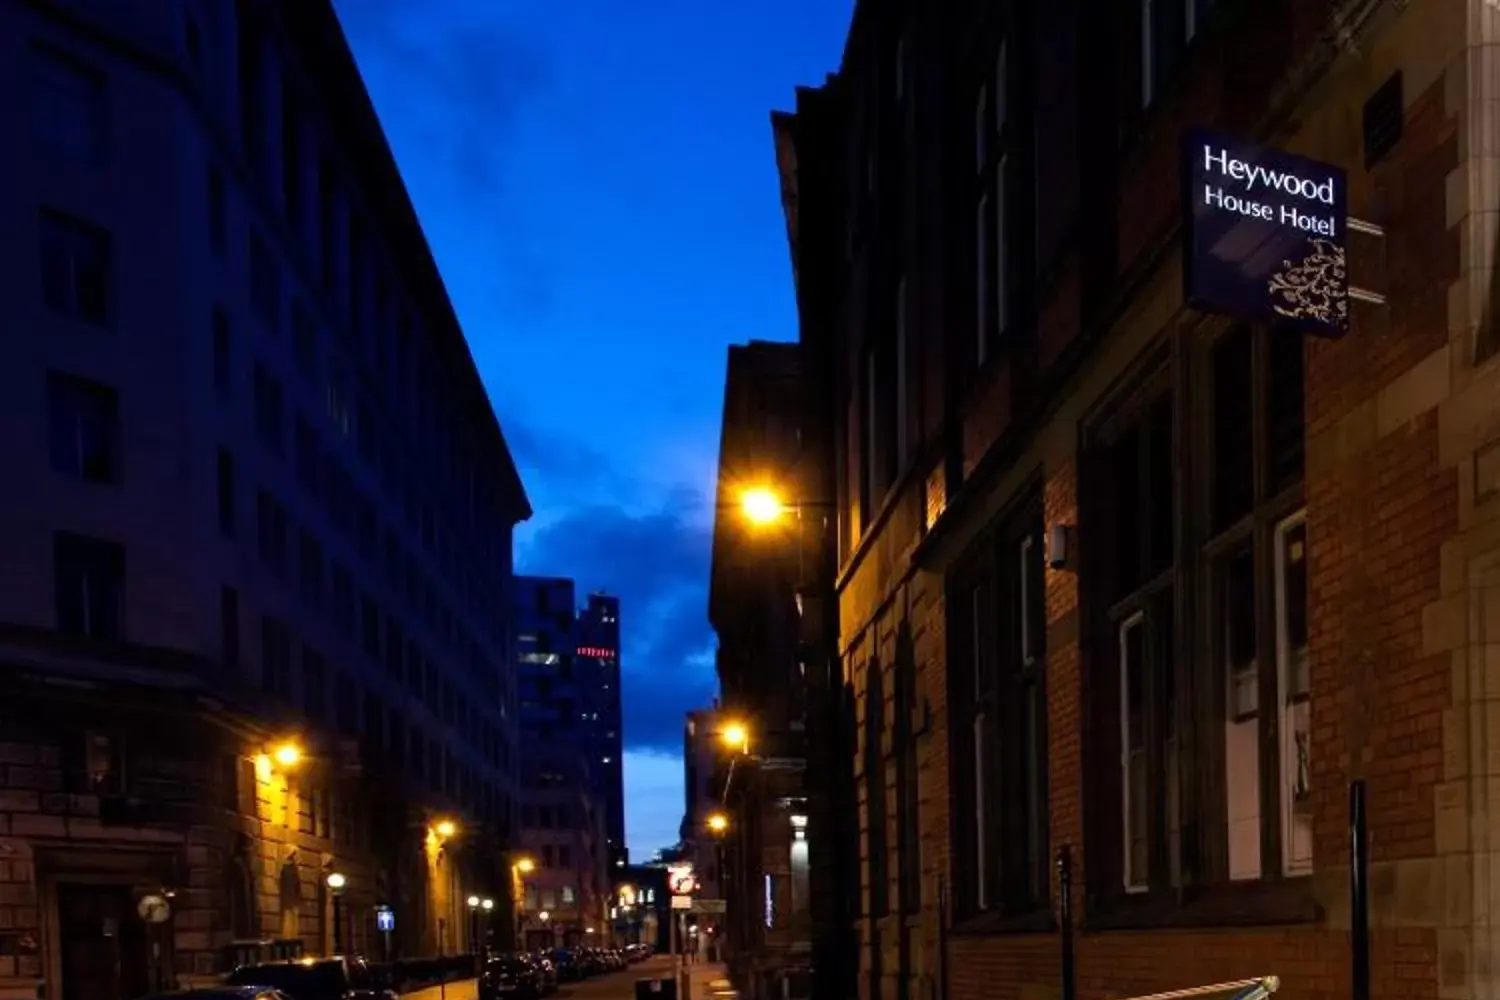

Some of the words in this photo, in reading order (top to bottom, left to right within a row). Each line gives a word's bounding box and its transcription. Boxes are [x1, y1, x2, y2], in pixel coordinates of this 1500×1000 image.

[1204, 145, 1334, 205] Heywood
[1204, 185, 1273, 221] House
[1280, 205, 1335, 237] Hotel
